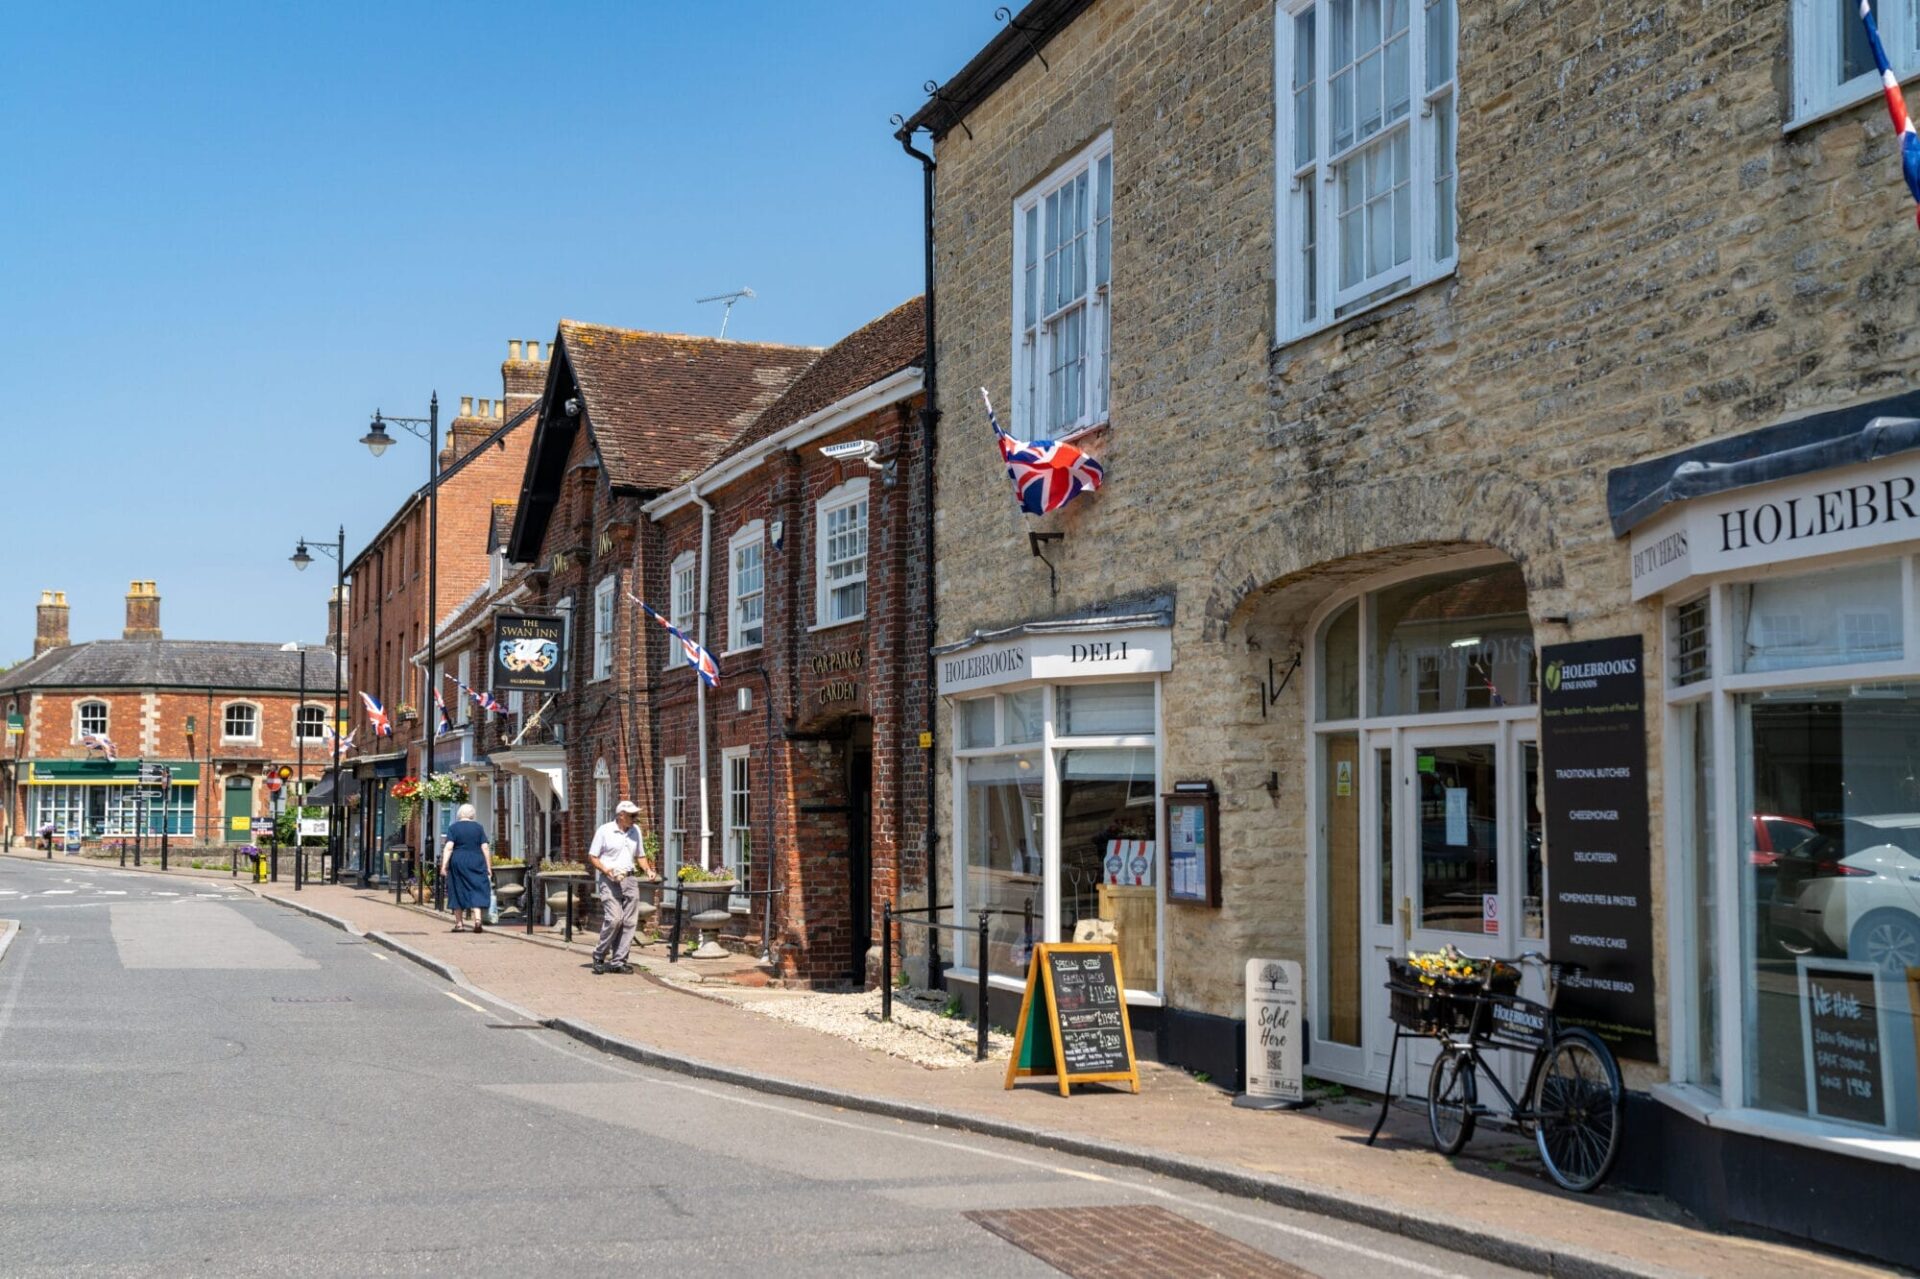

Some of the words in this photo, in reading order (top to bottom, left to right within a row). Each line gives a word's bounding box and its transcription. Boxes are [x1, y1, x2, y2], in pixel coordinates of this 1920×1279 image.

[1718, 476, 1920, 552] HOLEBR
[1633, 529, 1690, 580] BUTCHERS
[501, 626, 533, 638] SWAN
[536, 628, 558, 639] INN
[522, 619, 539, 628] THE
[812, 655, 829, 674] CAR
[830, 651, 853, 671] PARK
[1071, 641, 1128, 664] DELI
[945, 646, 1024, 684] HOLEBROOKS
[1562, 659, 1637, 679] HOLEBROOKS
[819, 681, 855, 705] GARDEN
[1561, 681, 1575, 691] FINE
[1576, 679, 1598, 689] FOODS
[1555, 768, 1596, 779] TRADITIONAL
[1597, 767, 1631, 778] BUTCHERS
[1568, 810, 1619, 820] CHEESEMONGER
[1573, 852, 1617, 862] DELICATESSEN
[1558, 892, 1594, 904] HOMEMADE
[1594, 894, 1606, 905] PIES
[1607, 896, 1612, 905] &
[1612, 896, 1637, 907] PASTIES
[1569, 934, 1605, 948] HOMEMADE
[1606, 937, 1628, 949] CAKES
[1593, 978, 1612, 991] MADE
[1613, 980, 1635, 994] BREAD
[1258, 1006, 1289, 1029] Sold
[1493, 1003, 1544, 1030] HOLEBROOKS
[1260, 1027, 1287, 1047] Here
